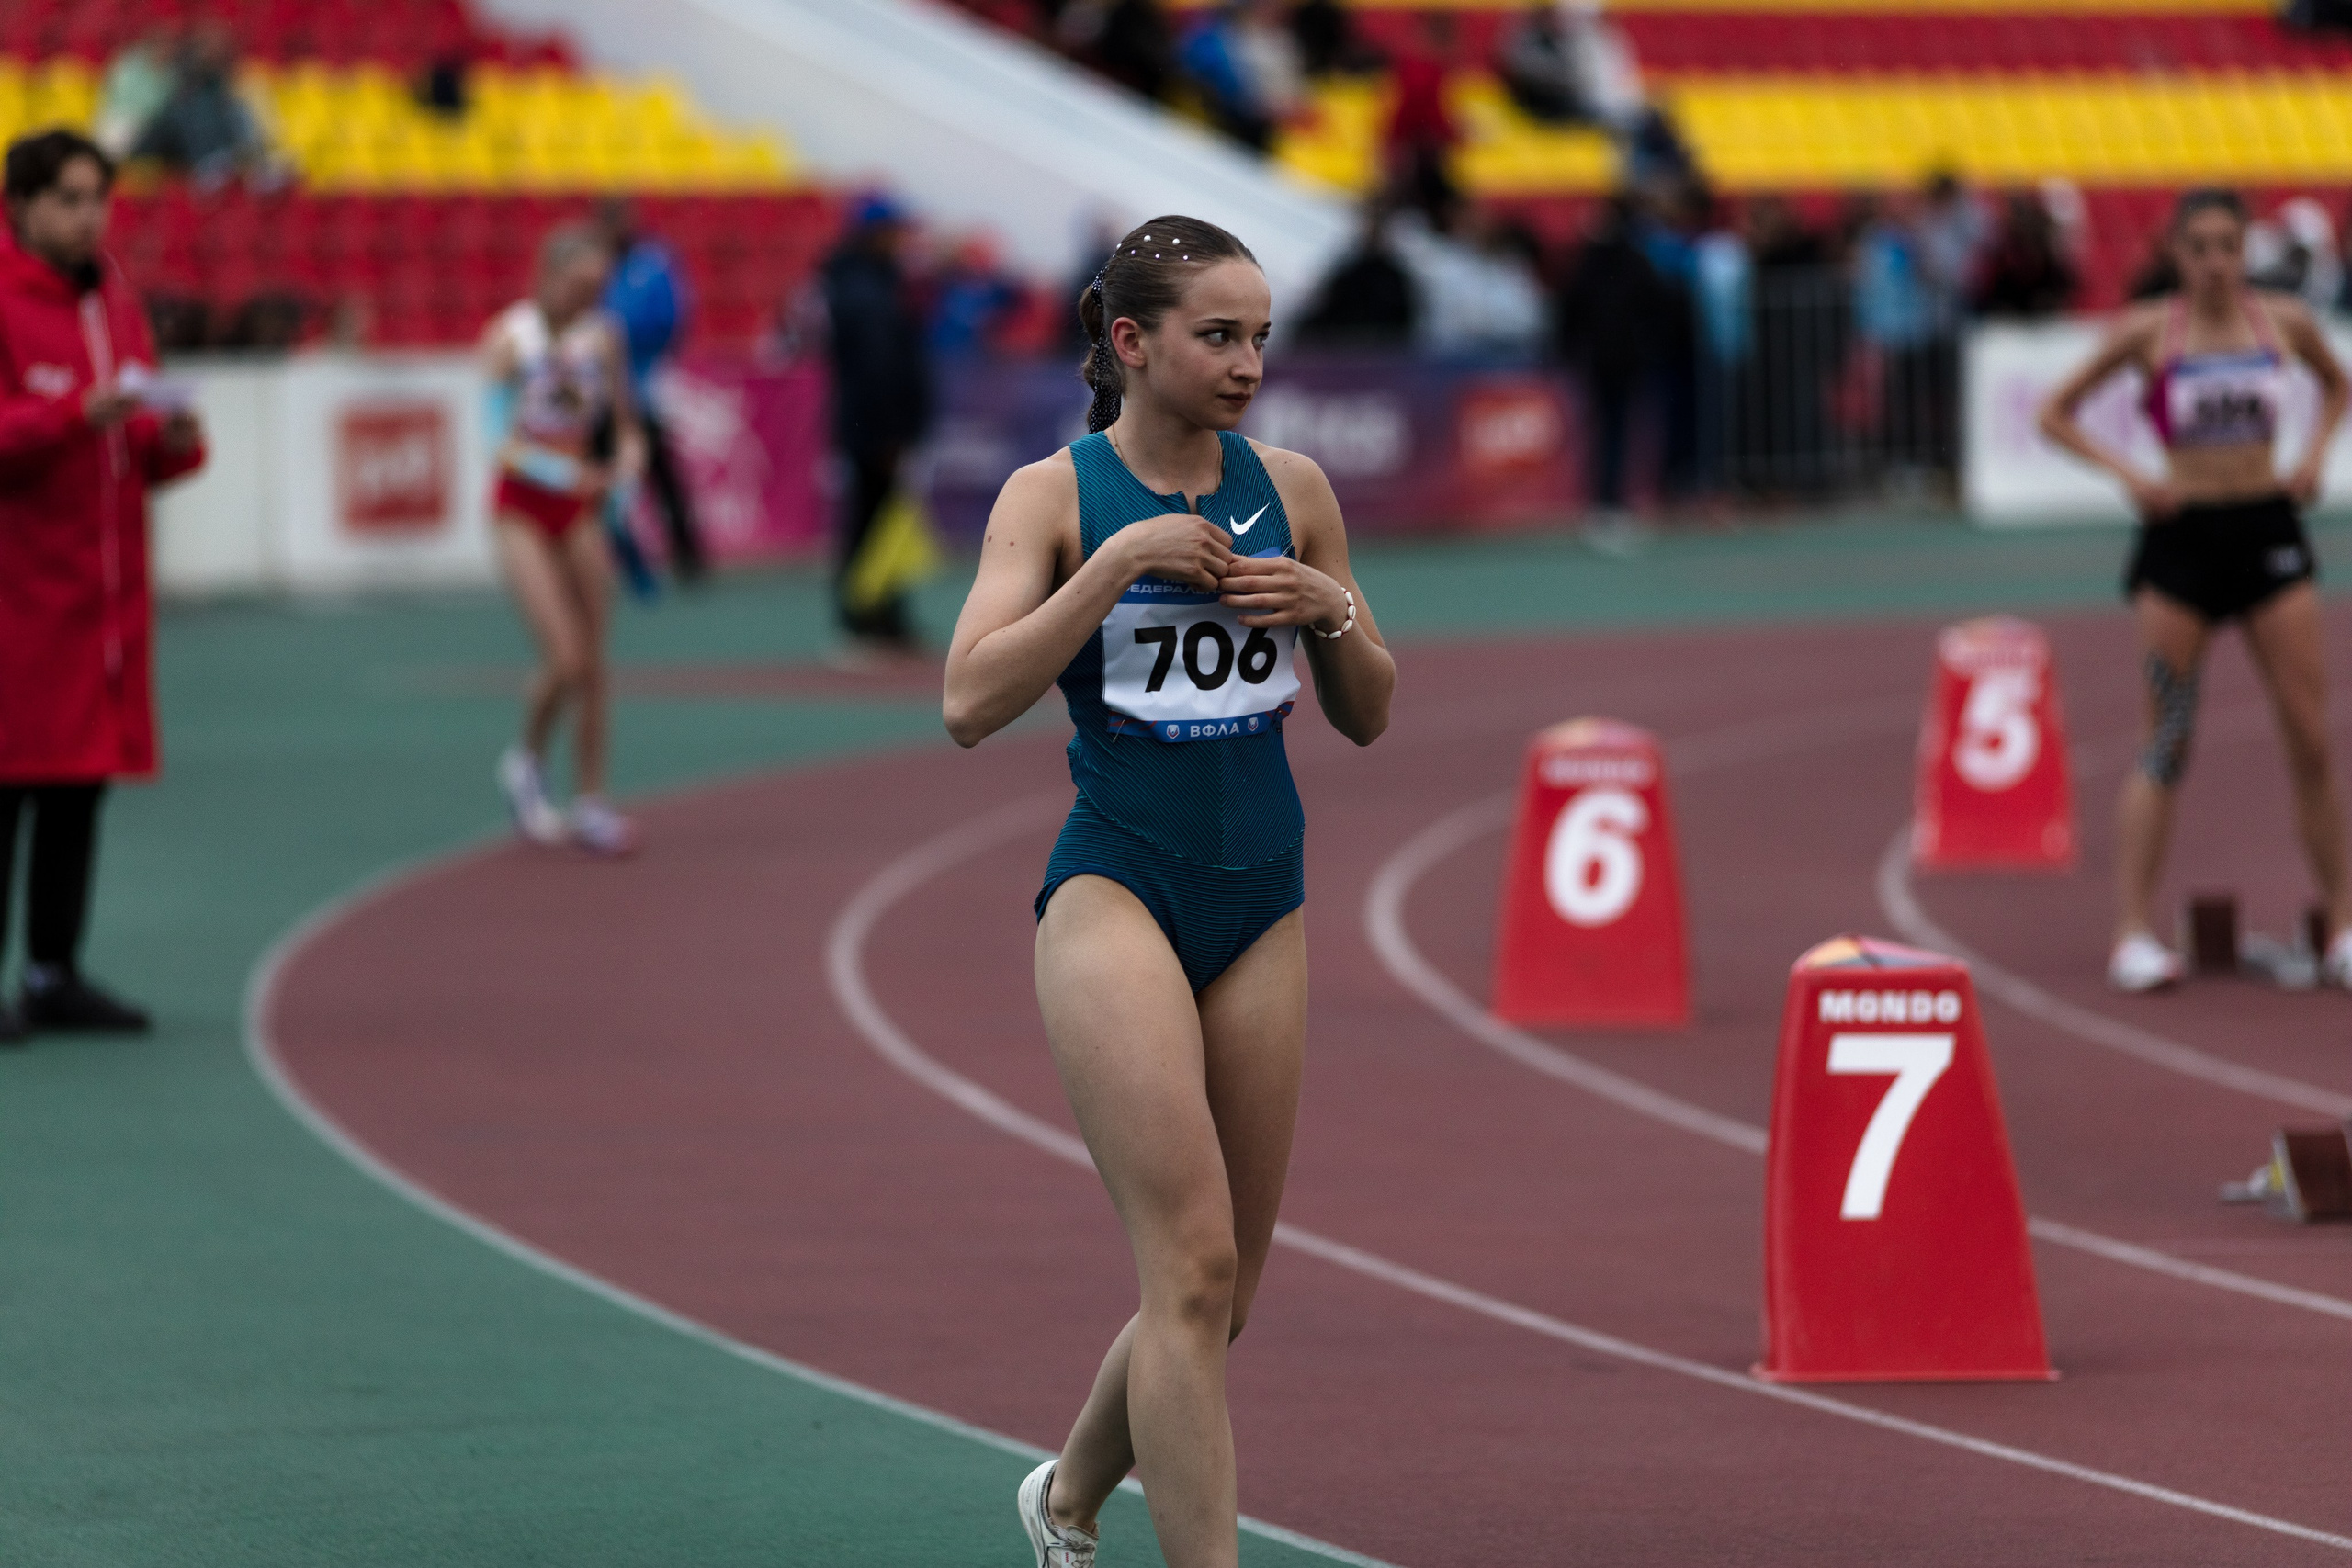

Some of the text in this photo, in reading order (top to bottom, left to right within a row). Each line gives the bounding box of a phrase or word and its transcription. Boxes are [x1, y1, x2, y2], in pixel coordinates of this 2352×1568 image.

[1134, 621, 1278, 693] 706
[1190, 722, 1240, 738] ВФЛА
[1951, 670, 2041, 792] 5
[1544, 788, 1651, 927] 6
[1819, 989, 1962, 1025] MONDO
[1826, 1032, 1956, 1220] 7
